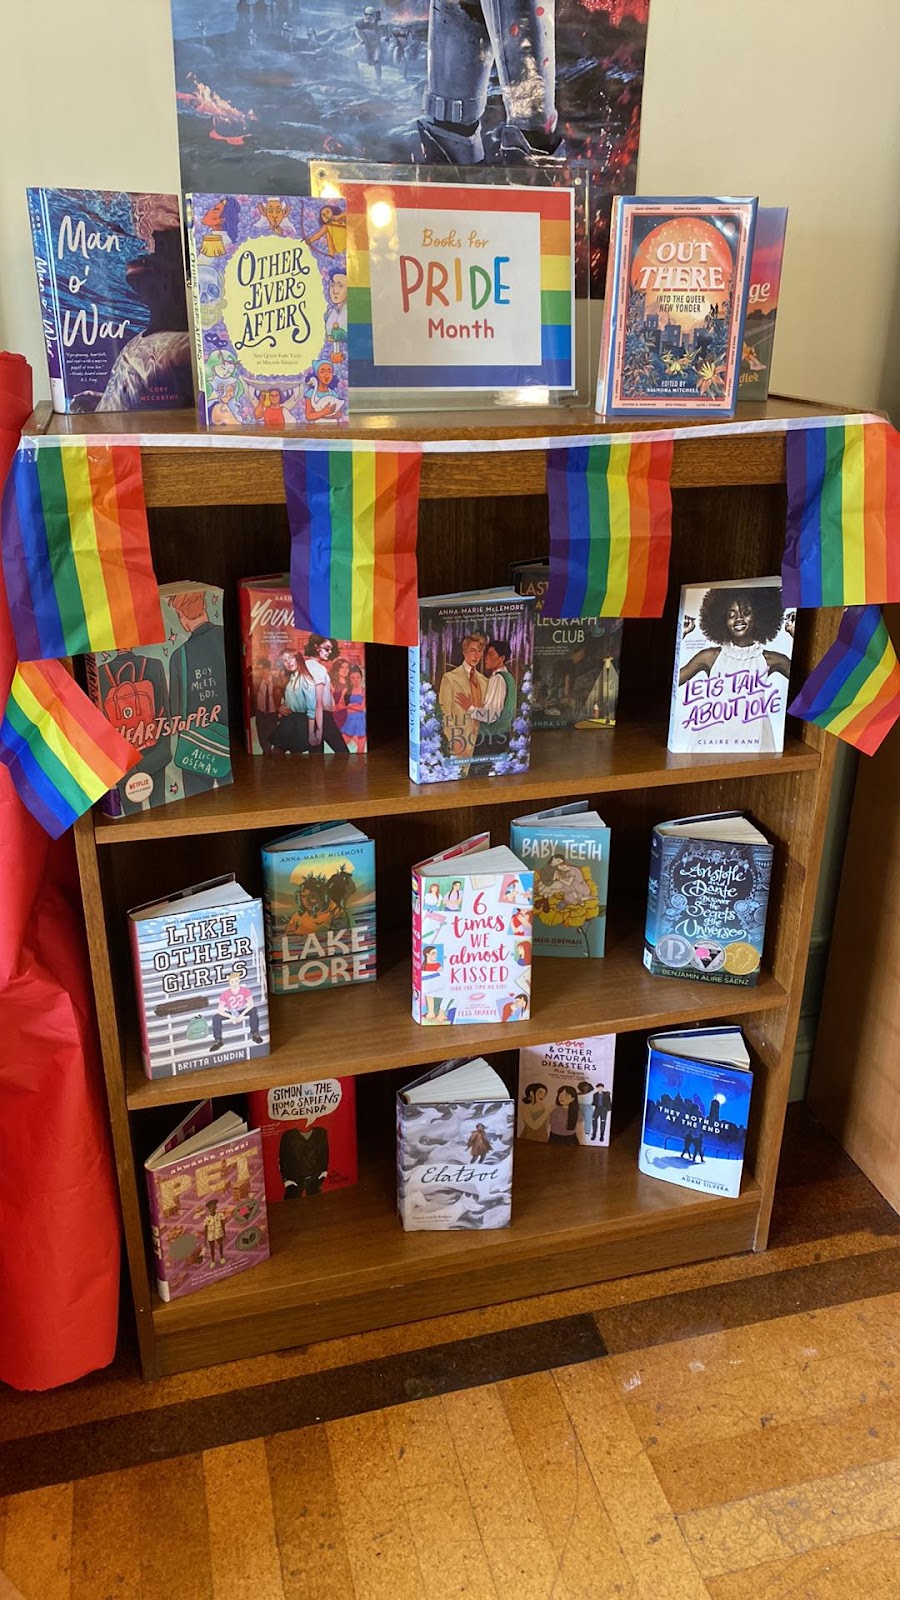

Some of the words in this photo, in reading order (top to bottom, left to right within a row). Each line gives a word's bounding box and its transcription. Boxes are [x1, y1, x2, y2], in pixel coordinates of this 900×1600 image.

[58, 215, 121, 259] Man
[422, 228, 462, 248] Books
[468, 230, 490, 248] for
[656, 241, 712, 262] OUT
[237, 247, 310, 286] OTHER
[68, 264, 89, 293] o'
[400, 254, 510, 313] PRIDE
[639, 266, 726, 290] THERE
[244, 277, 306, 310] EVER
[656, 294, 671, 304] INTO
[672, 294, 684, 304] THE
[685, 294, 706, 304] QUEER
[748, 282, 771, 304] ge
[34, 256, 48, 292] Man
[43, 319, 58, 358] War
[659, 304, 674, 312] NEW
[676, 304, 701, 312] YONDER
[63, 303, 130, 347] War
[234, 301, 310, 350] AFTERS
[428, 318, 494, 339] Month
[661, 380, 678, 388] EDITED
[438, 606, 484, 616] ANNA-MARIE
[485, 604, 524, 612] McLEMORE
[535, 600, 544, 609] A
[534, 613, 597, 627] LEGRAPH
[552, 629, 585, 644] CLUB
[194, 667, 213, 679] BOY
[191, 679, 216, 690] MEETS
[682, 672, 724, 706] LET'S
[725, 666, 773, 696] TALK
[682, 696, 746, 732] ABOUT
[742, 689, 782, 724] LOVE
[450, 727, 508, 755] BOYS
[182, 757, 218, 774] OSEMAN
[192, 748, 216, 763] ALICE
[128, 779, 150, 792] NETFLIX
[280, 852, 325, 862] ANNA-MARIE
[521, 838, 559, 859] BABY
[562, 839, 602, 861] TEETH
[680, 862, 746, 885] Aristotle
[681, 880, 738, 899] Dante
[472, 892, 486, 916] 6
[686, 900, 736, 922] Secrets
[710, 902, 720, 910] the
[166, 915, 238, 946] LIKE
[452, 914, 505, 938] times
[675, 918, 747, 940] Universe
[282, 926, 370, 962] LAKE
[470, 932, 490, 948] WE
[534, 936, 550, 944] MEG
[551, 937, 582, 945] GREHAN
[154, 936, 252, 972] OTHER
[449, 944, 510, 966] almost
[162, 960, 248, 994] GIRLS
[282, 954, 370, 991] LORE
[450, 966, 509, 984] KISSED
[662, 969, 700, 980] BENJAMIN
[228, 994, 245, 1008] 22
[178, 1058, 210, 1071] BRITTA
[213, 1050, 245, 1064] LUNDIN
[545, 1054, 593, 1063] NATURAL
[558, 1048, 592, 1056] OTHER
[542, 1060, 597, 1070] DISASTERS
[274, 1084, 302, 1101] SIMON
[314, 1082, 332, 1095] THE
[272, 1100, 294, 1116] HOMO
[297, 1092, 340, 1108] SAPIENS
[280, 1104, 327, 1117] AGENDA
[658, 1106, 680, 1117] THEY
[684, 1114, 710, 1125] BOTH
[714, 1121, 730, 1130] DIE
[666, 1115, 676, 1123] AT
[682, 1118, 698, 1128] THE
[702, 1126, 721, 1134] END
[170, 1154, 216, 1174] akwaeke
[220, 1142, 250, 1158] emezi
[158, 1146, 258, 1214] PET
[420, 1166, 499, 1184] Elatsoe
[682, 1176, 700, 1186] ADAM
[704, 1182, 729, 1192] SILVERA
[152, 1225, 162, 1260] PET
